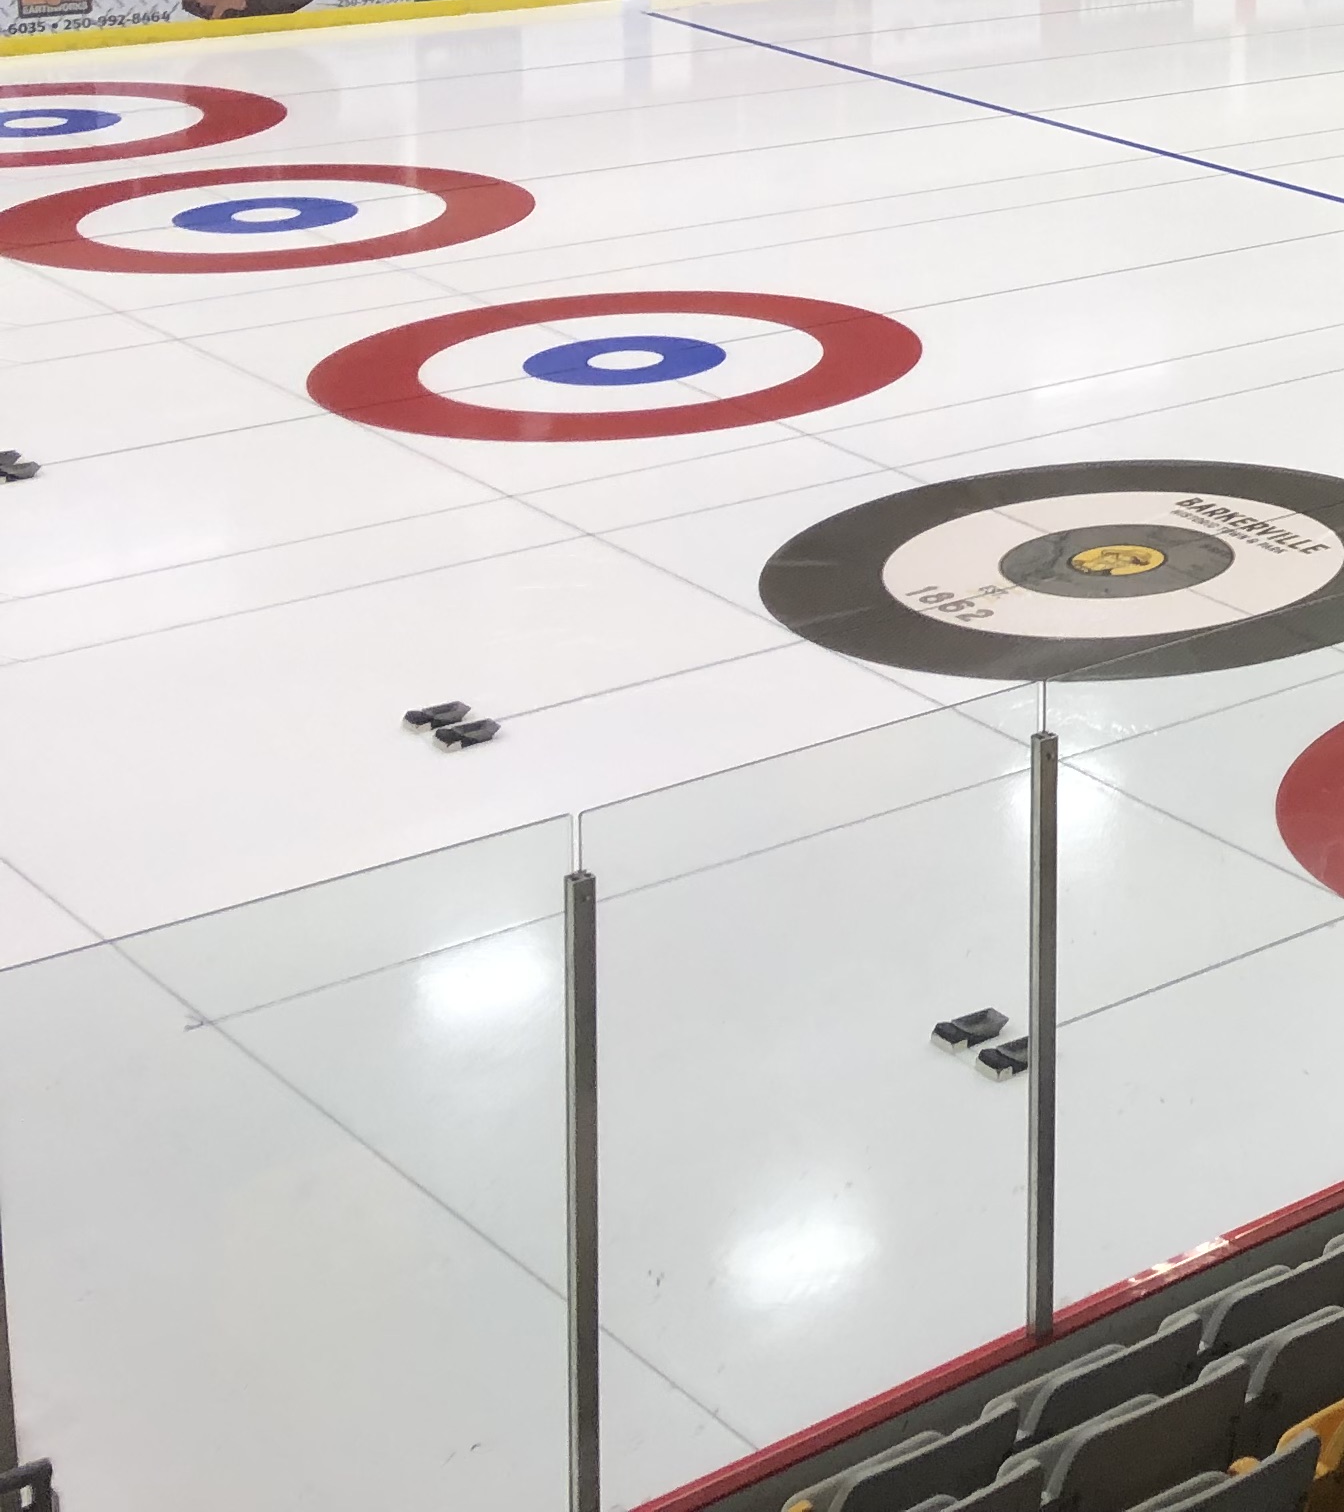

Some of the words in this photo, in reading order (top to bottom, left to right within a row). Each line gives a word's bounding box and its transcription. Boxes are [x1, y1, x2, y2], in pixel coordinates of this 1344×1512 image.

[1174, 497, 1331, 555] BARKERVILLE
[1257, 541, 1289, 555] PARK
[905, 585, 995, 622] 1862
